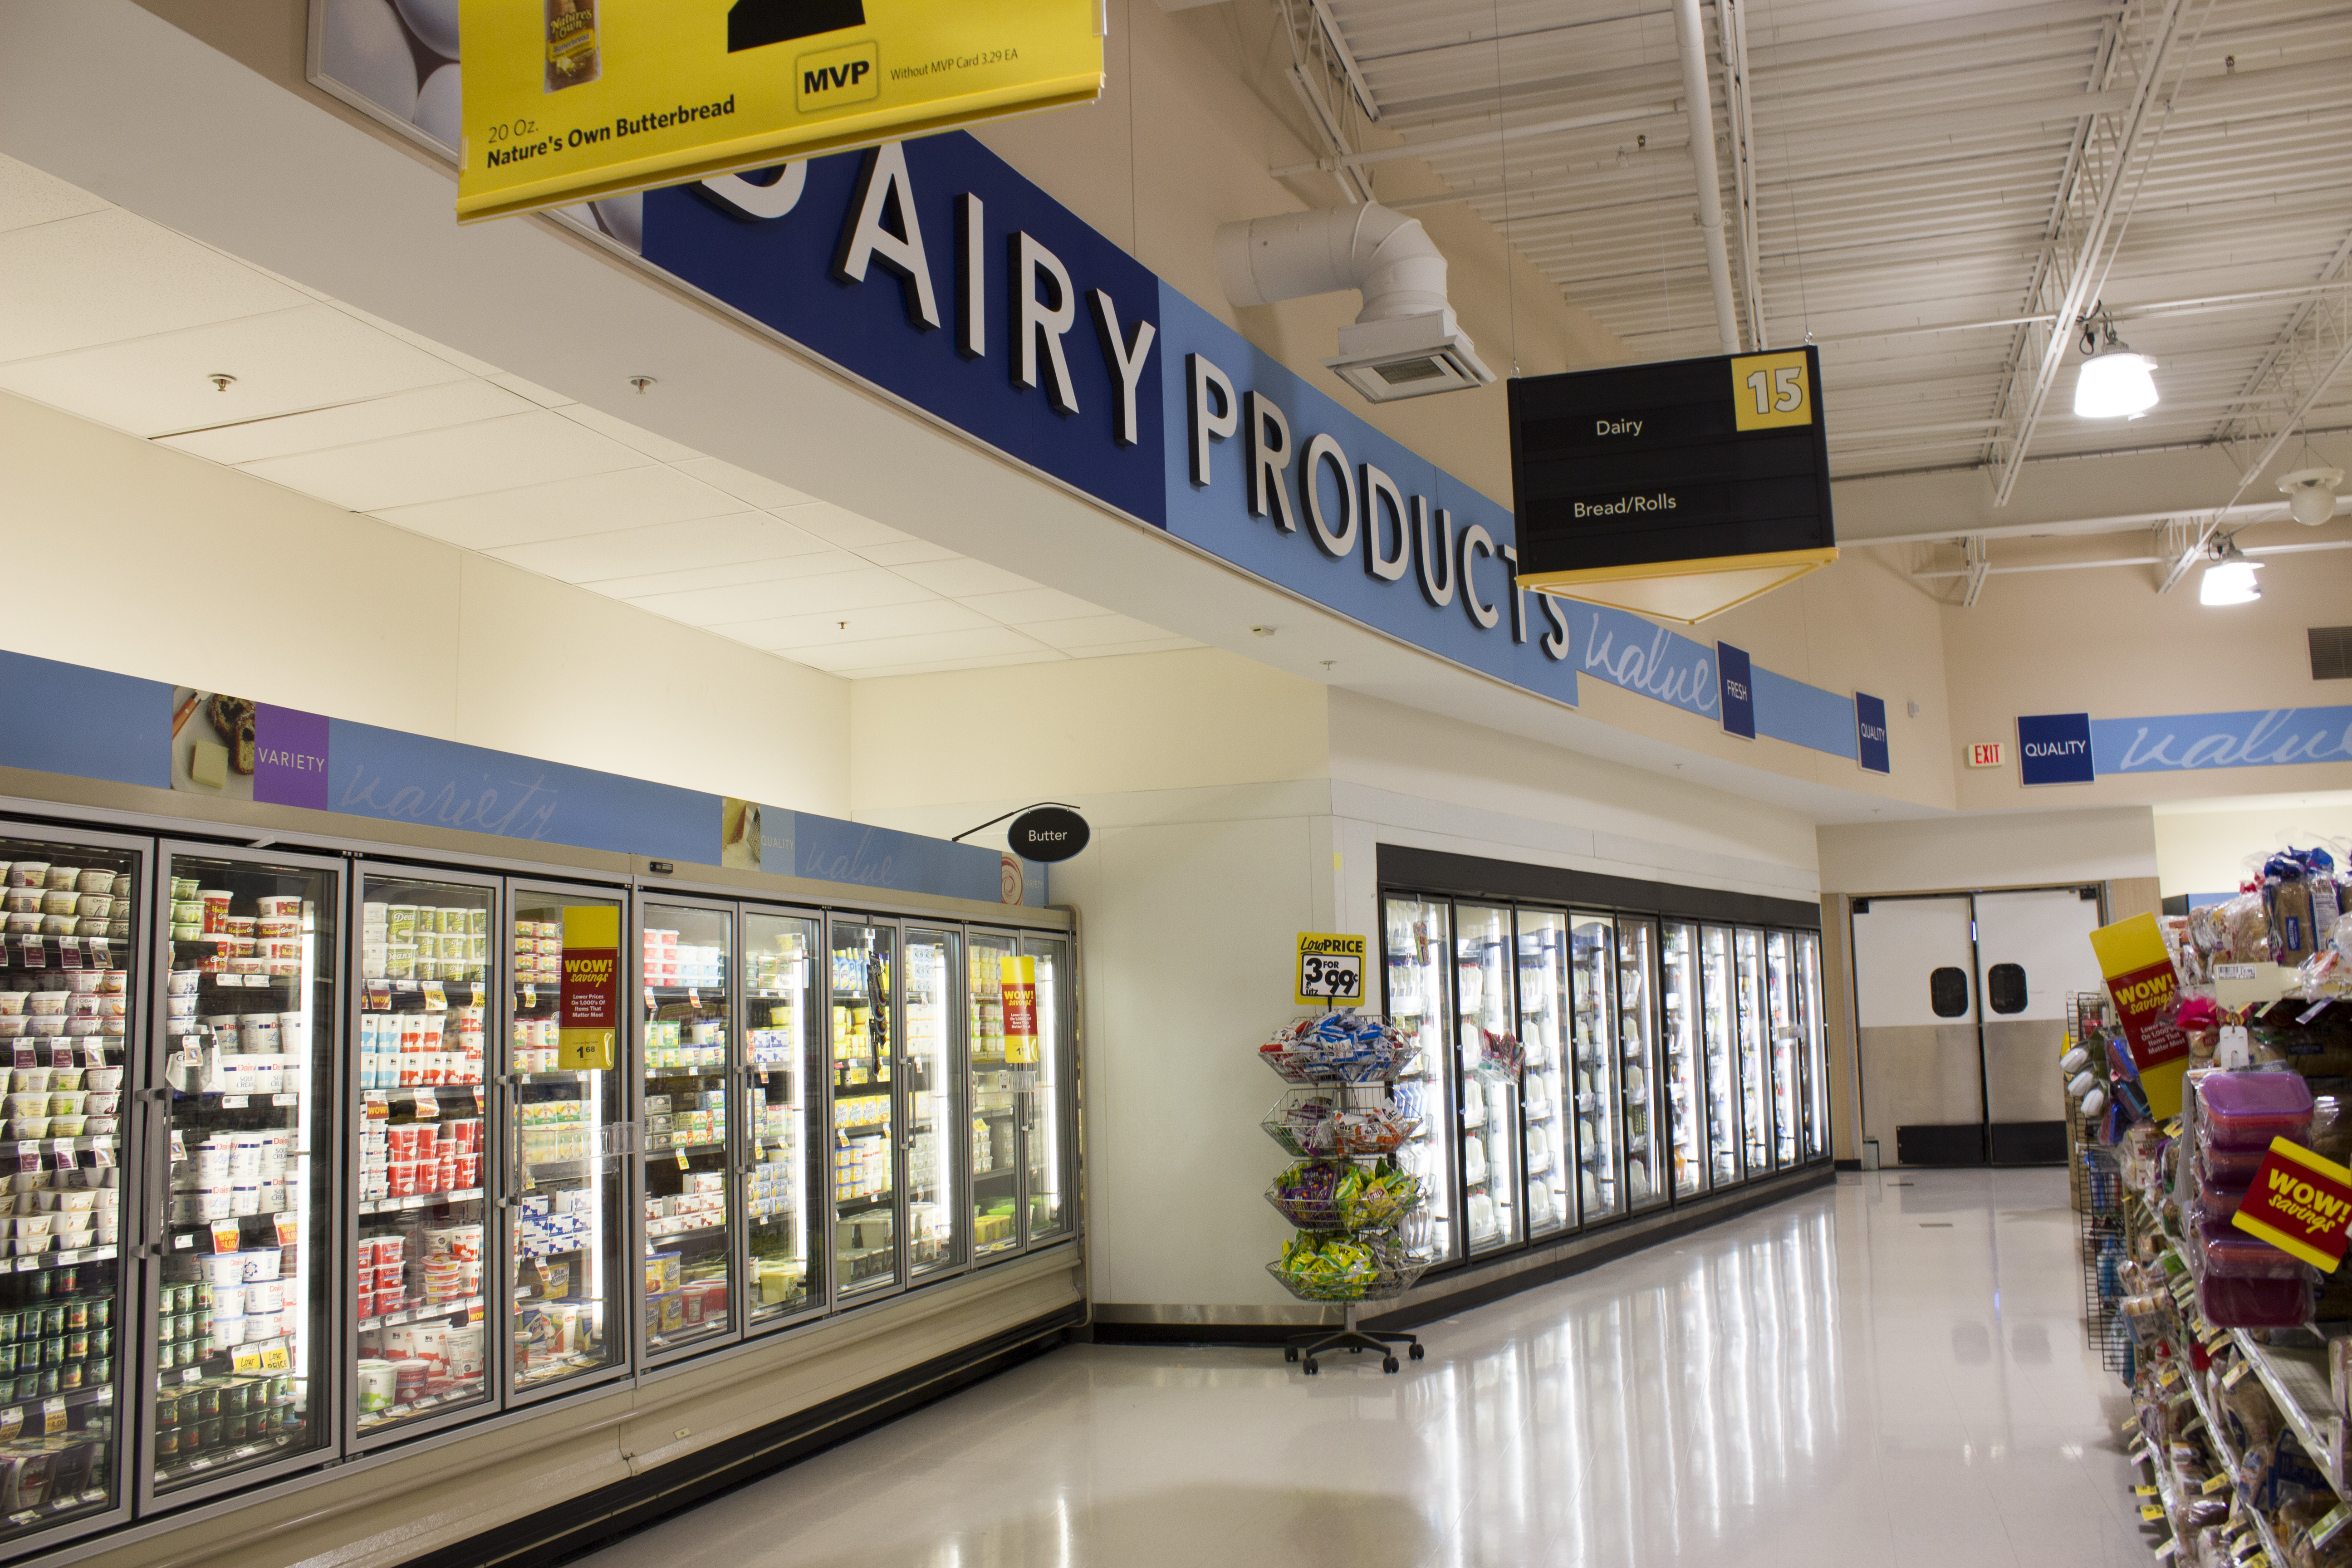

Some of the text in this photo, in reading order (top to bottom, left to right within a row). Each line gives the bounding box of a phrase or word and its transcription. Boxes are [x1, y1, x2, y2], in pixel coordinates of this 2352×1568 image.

[890, 48, 1018, 81] Without MVP Card 3.29 EA
[804, 59, 869, 94] MVP
[487, 94, 735, 168] Nature's Own Butterbread
[488, 118, 539, 144] 20 Oz.
[691, 140, 1157, 448] AIRY
[1747, 366, 1803, 414] 15
[1597, 418, 1642, 437] Dairy
[1574, 493, 1676, 518] Bread/Rolls
[1727, 680, 1747, 701] FRESH
[1861, 723, 1885, 742] QUALITY
[1975, 744, 2000, 764] EXIT
[2025, 740, 2086, 757] QUALITY
[258, 748, 325, 773] VARIETY
[761, 835, 794, 851] QUALITY
[1029, 830, 1068, 842] Butter
[1024, 878, 1044, 889] VARIETY
[1323, 939, 1362, 953] PRICE
[565, 960, 612, 973] WOW!
[1305, 958, 1323, 983] 3
[570, 973, 608, 987] savings
[2116, 973, 2175, 1006] WOW!
[1004, 990, 1034, 1000] WOW!
[1009, 1000, 1032, 1009] savings
[2130, 990, 2173, 1015] savings
[2140, 1023, 2158, 1034] Lower
[2148, 1031, 2180, 1046] Items That
[2148, 1039, 2185, 1055] Matter Most
[2269, 1168, 2352, 1225] WOW!
[2269, 1193, 2336, 1234] savings
[470, 1312, 484, 1321] WOW
[241, 1357, 255, 1367] Low
[268, 1360, 288, 1368] PRICE
[269, 1352, 282, 1361] Low
